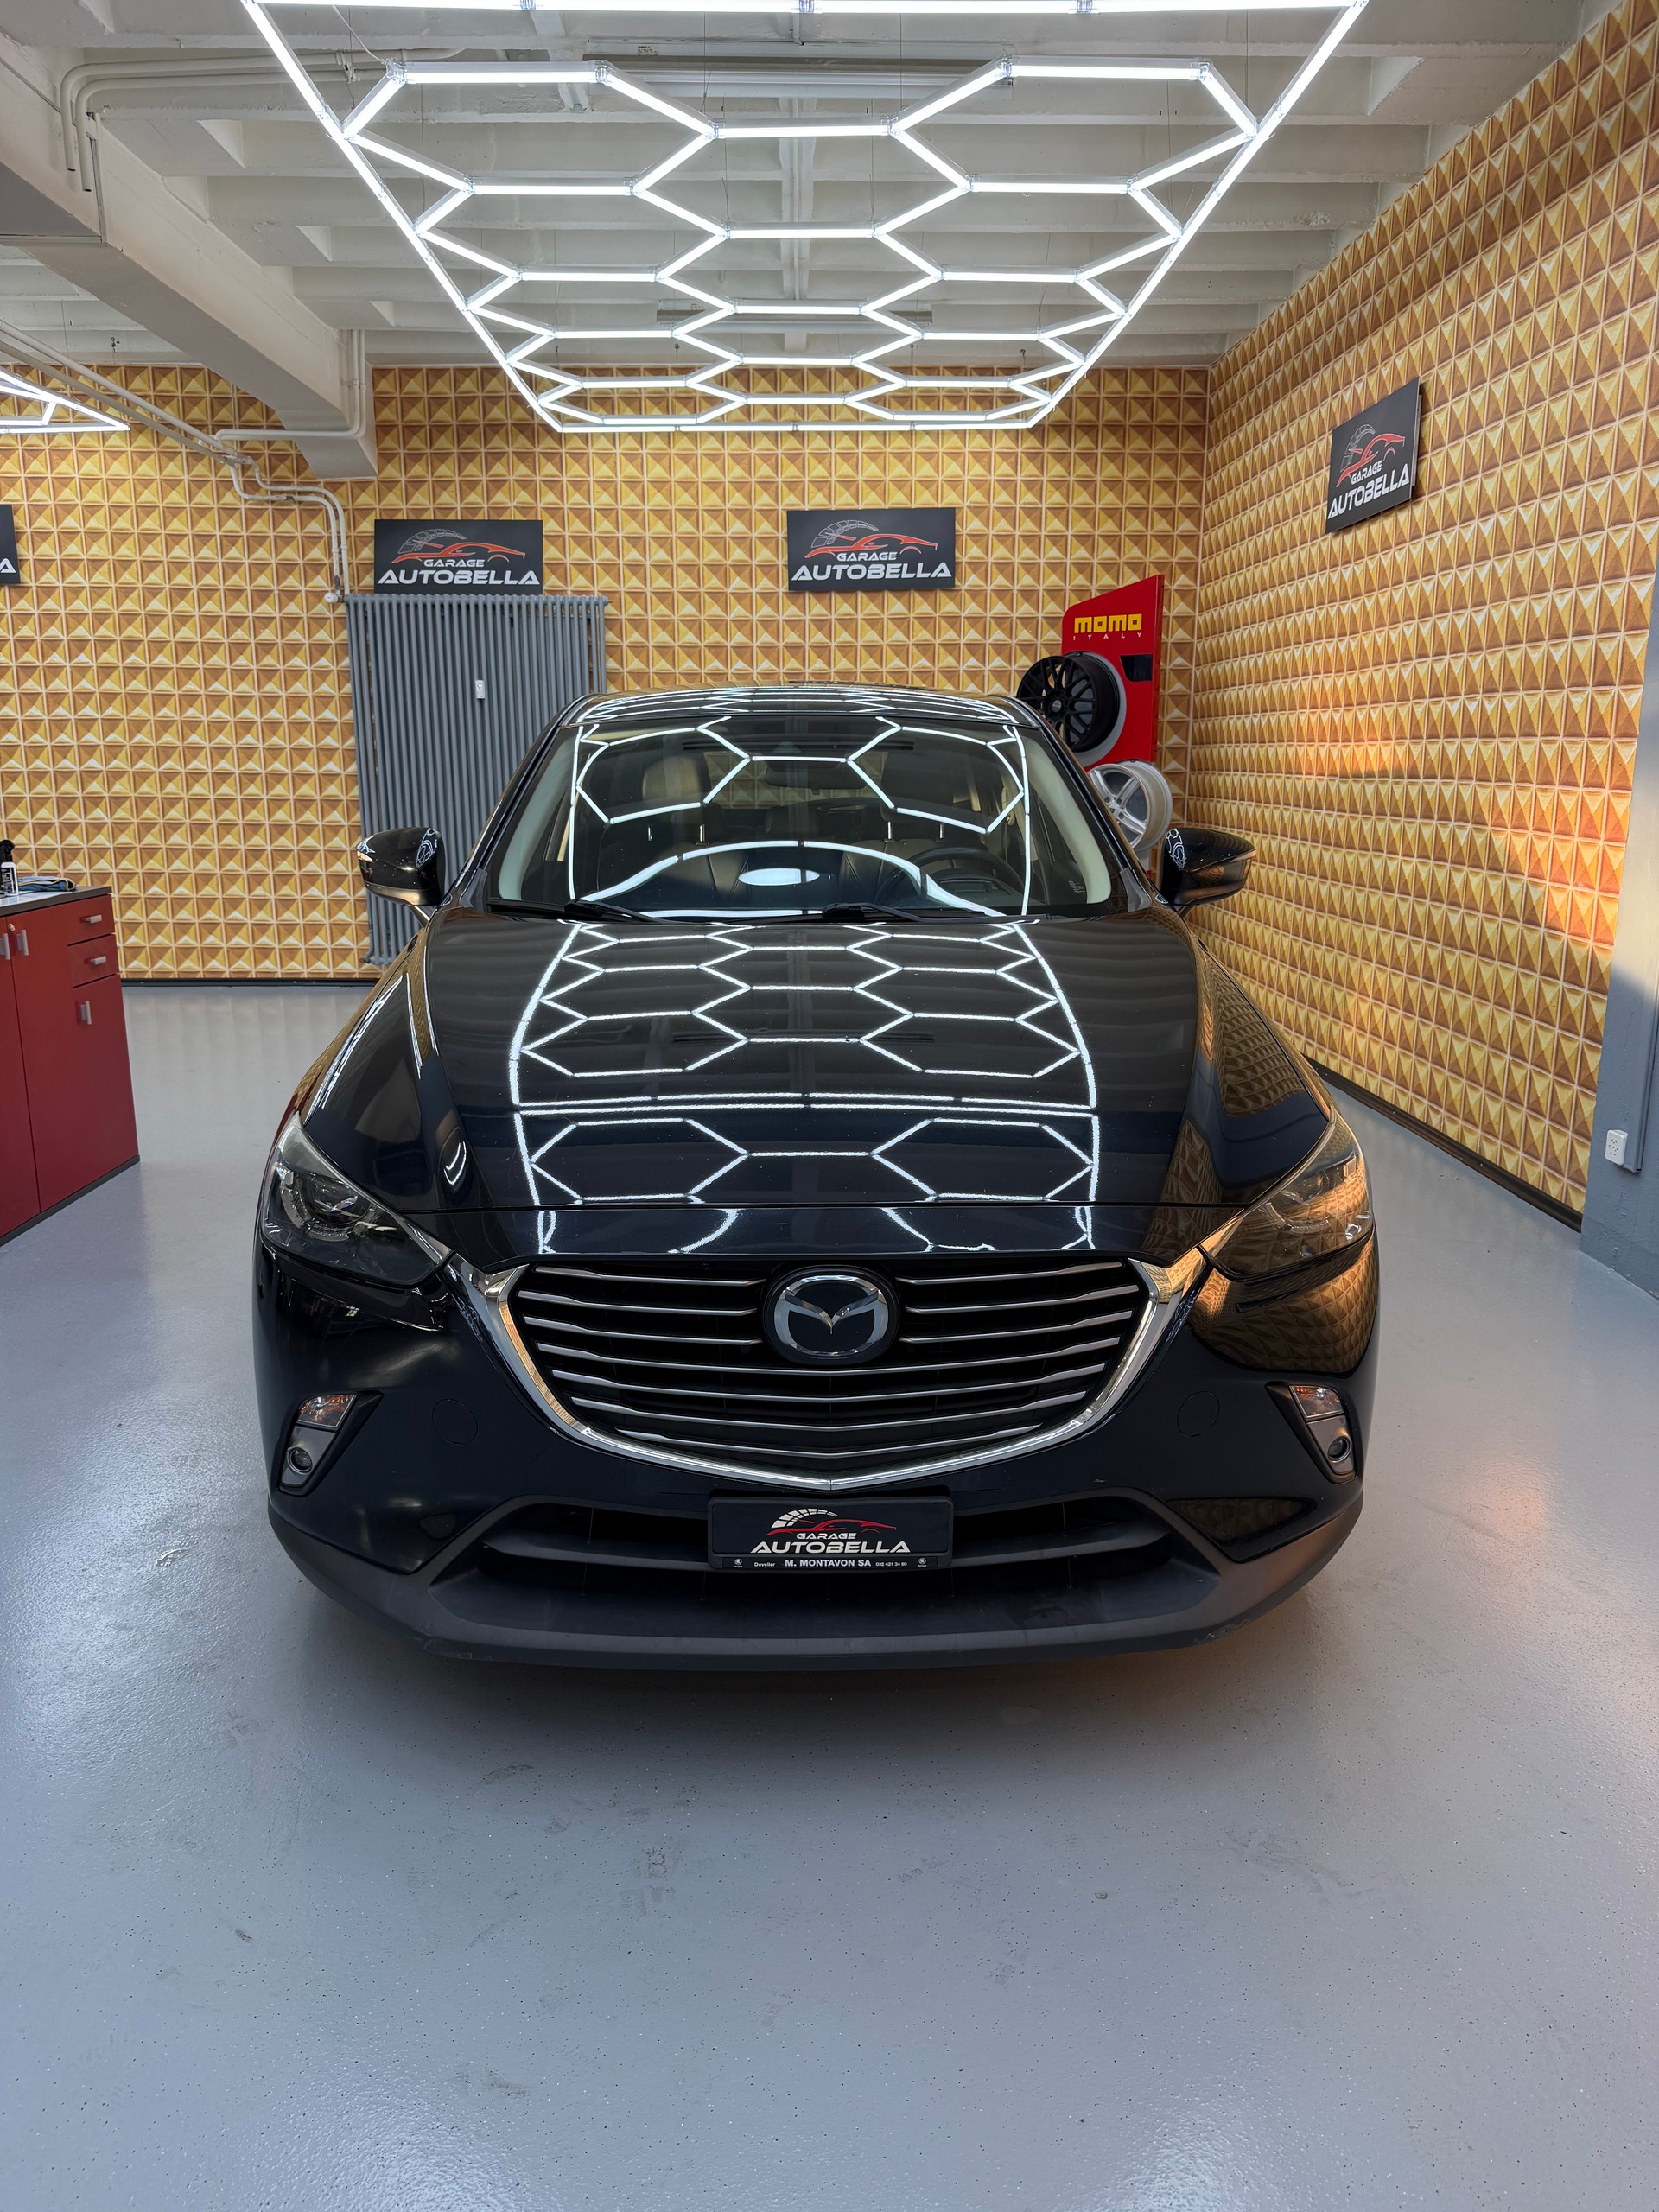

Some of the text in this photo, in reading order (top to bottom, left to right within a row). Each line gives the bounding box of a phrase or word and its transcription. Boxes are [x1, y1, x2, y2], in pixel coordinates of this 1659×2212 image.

[1351, 460, 1383, 485] GARAGE
[1327, 463, 1410, 519] AUTOBELLA
[423, 559, 486, 568] GARAGE
[837, 551, 898, 562] GARAGE
[377, 569, 540, 585] AUTOBELLA
[791, 562, 952, 581] AUTOBELLA
[1073, 632, 1141, 640] ITALY
[750, 1541, 911, 1554] AUTOBELLA
